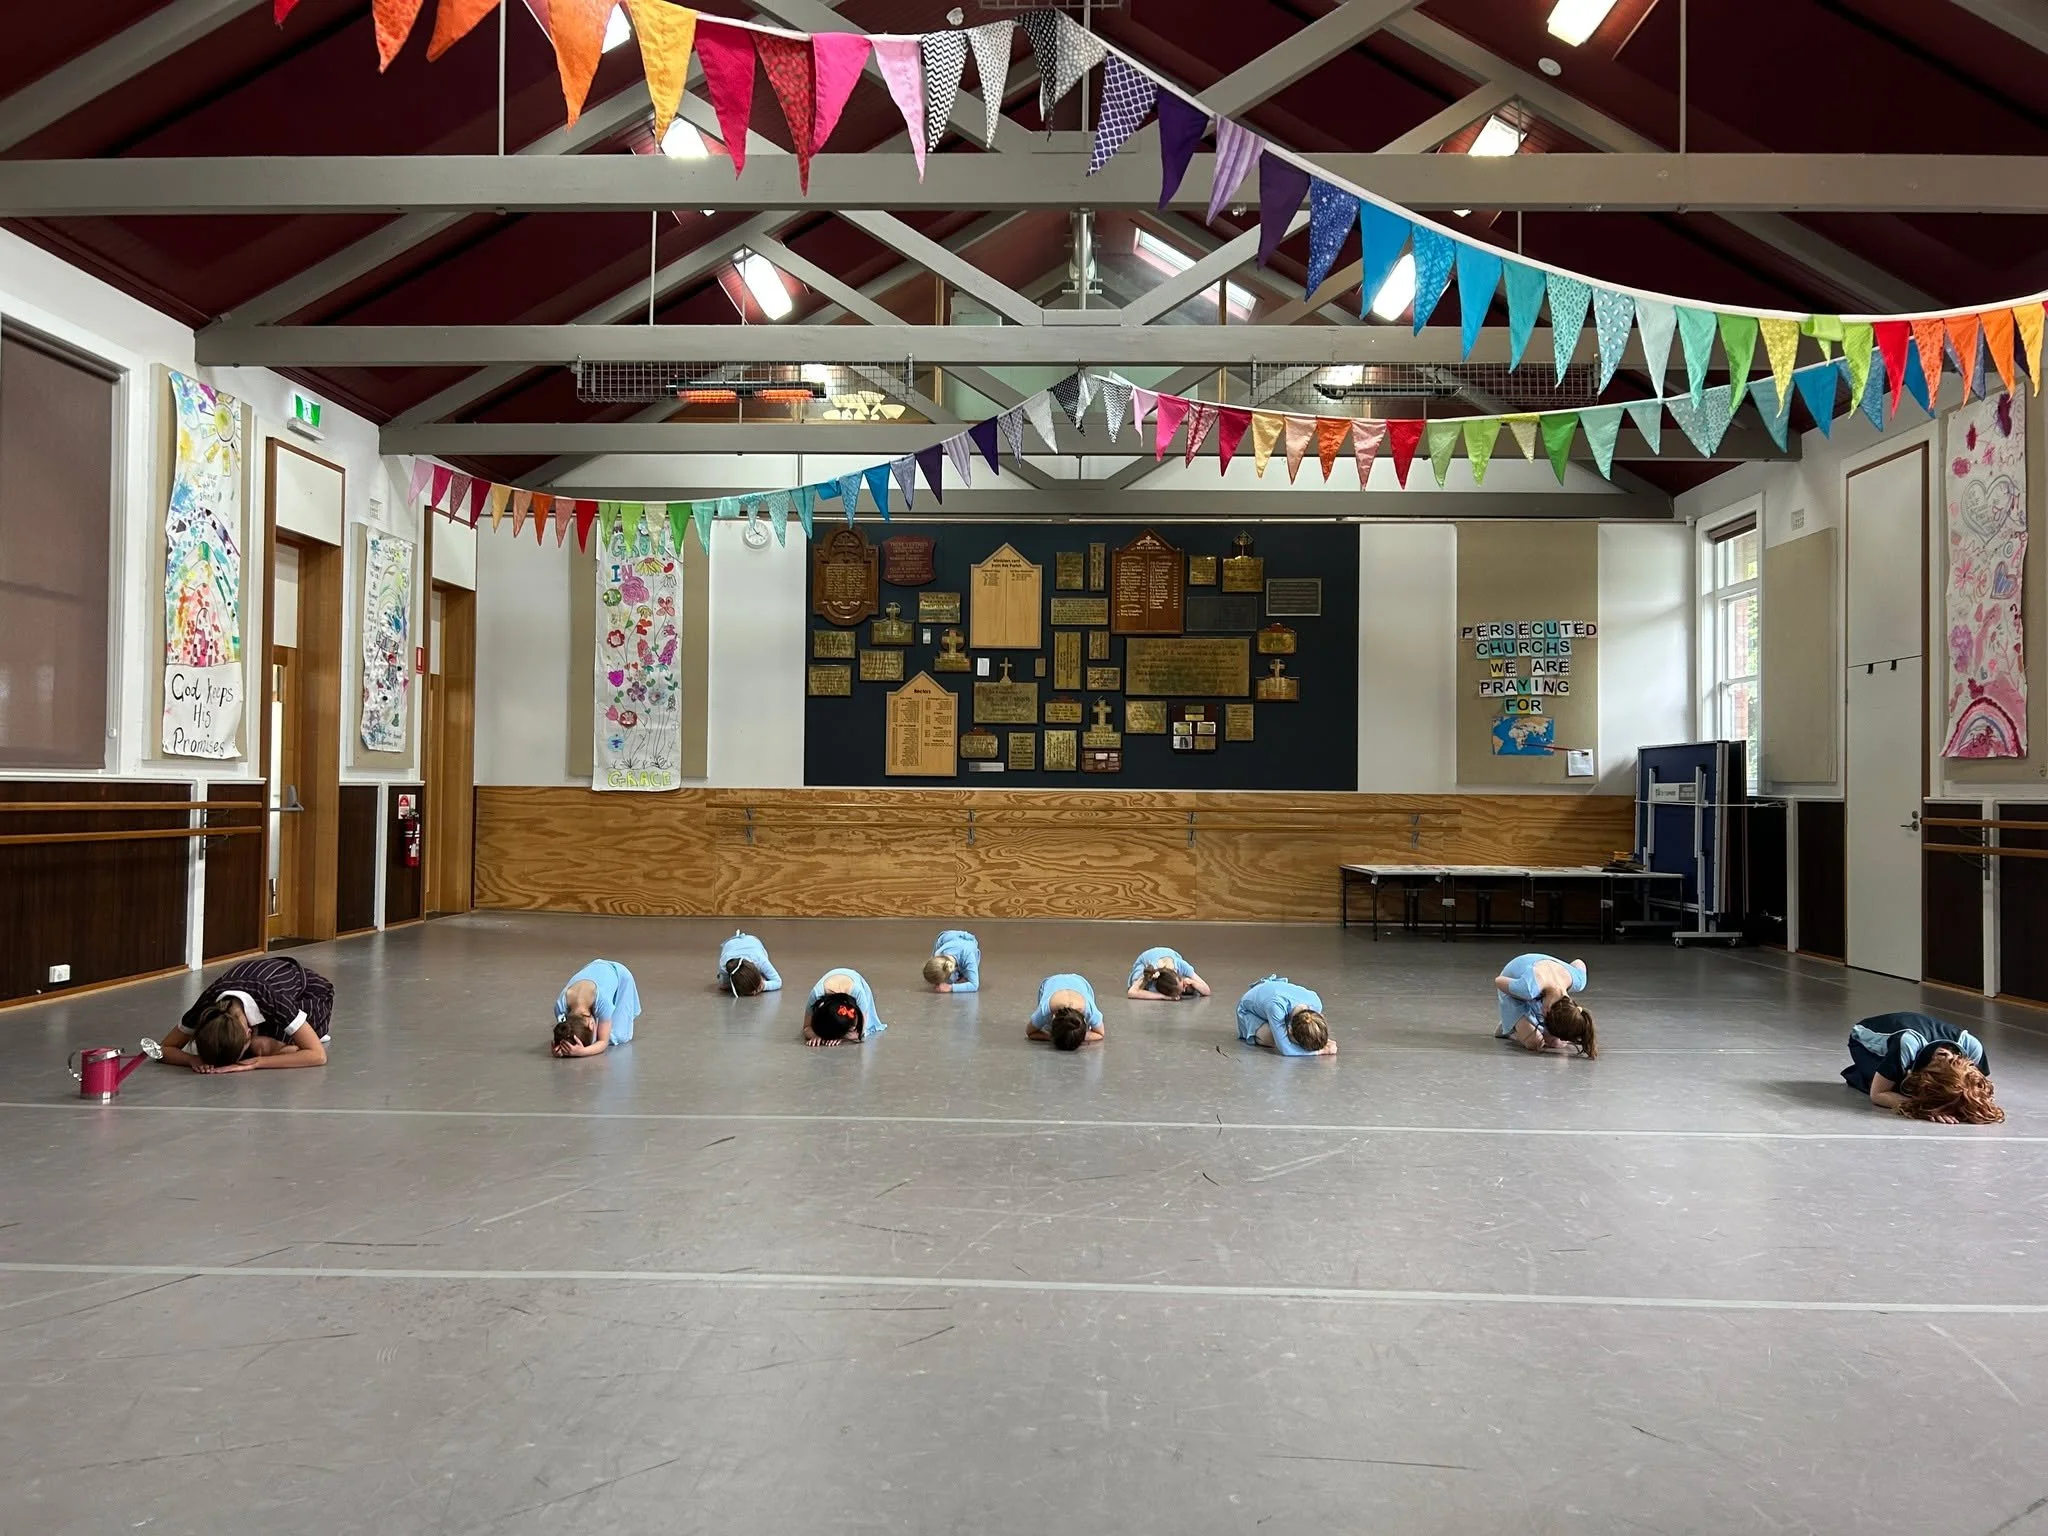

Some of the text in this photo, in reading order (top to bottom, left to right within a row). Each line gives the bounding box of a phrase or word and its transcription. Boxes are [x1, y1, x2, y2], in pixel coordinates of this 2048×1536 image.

[1462, 623, 1597, 639] PERSECUTED
[1477, 641, 1570, 655] CHURCHS
[1491, 661, 1570, 674] WE ARE
[172, 673, 234, 707] God keeps
[1480, 680, 1570, 694] PRAYING
[1505, 699, 1542, 711] FOR
[194, 702, 212, 729] His
[173, 727, 225, 757] Promises
[608, 771, 671, 788] GRACE
